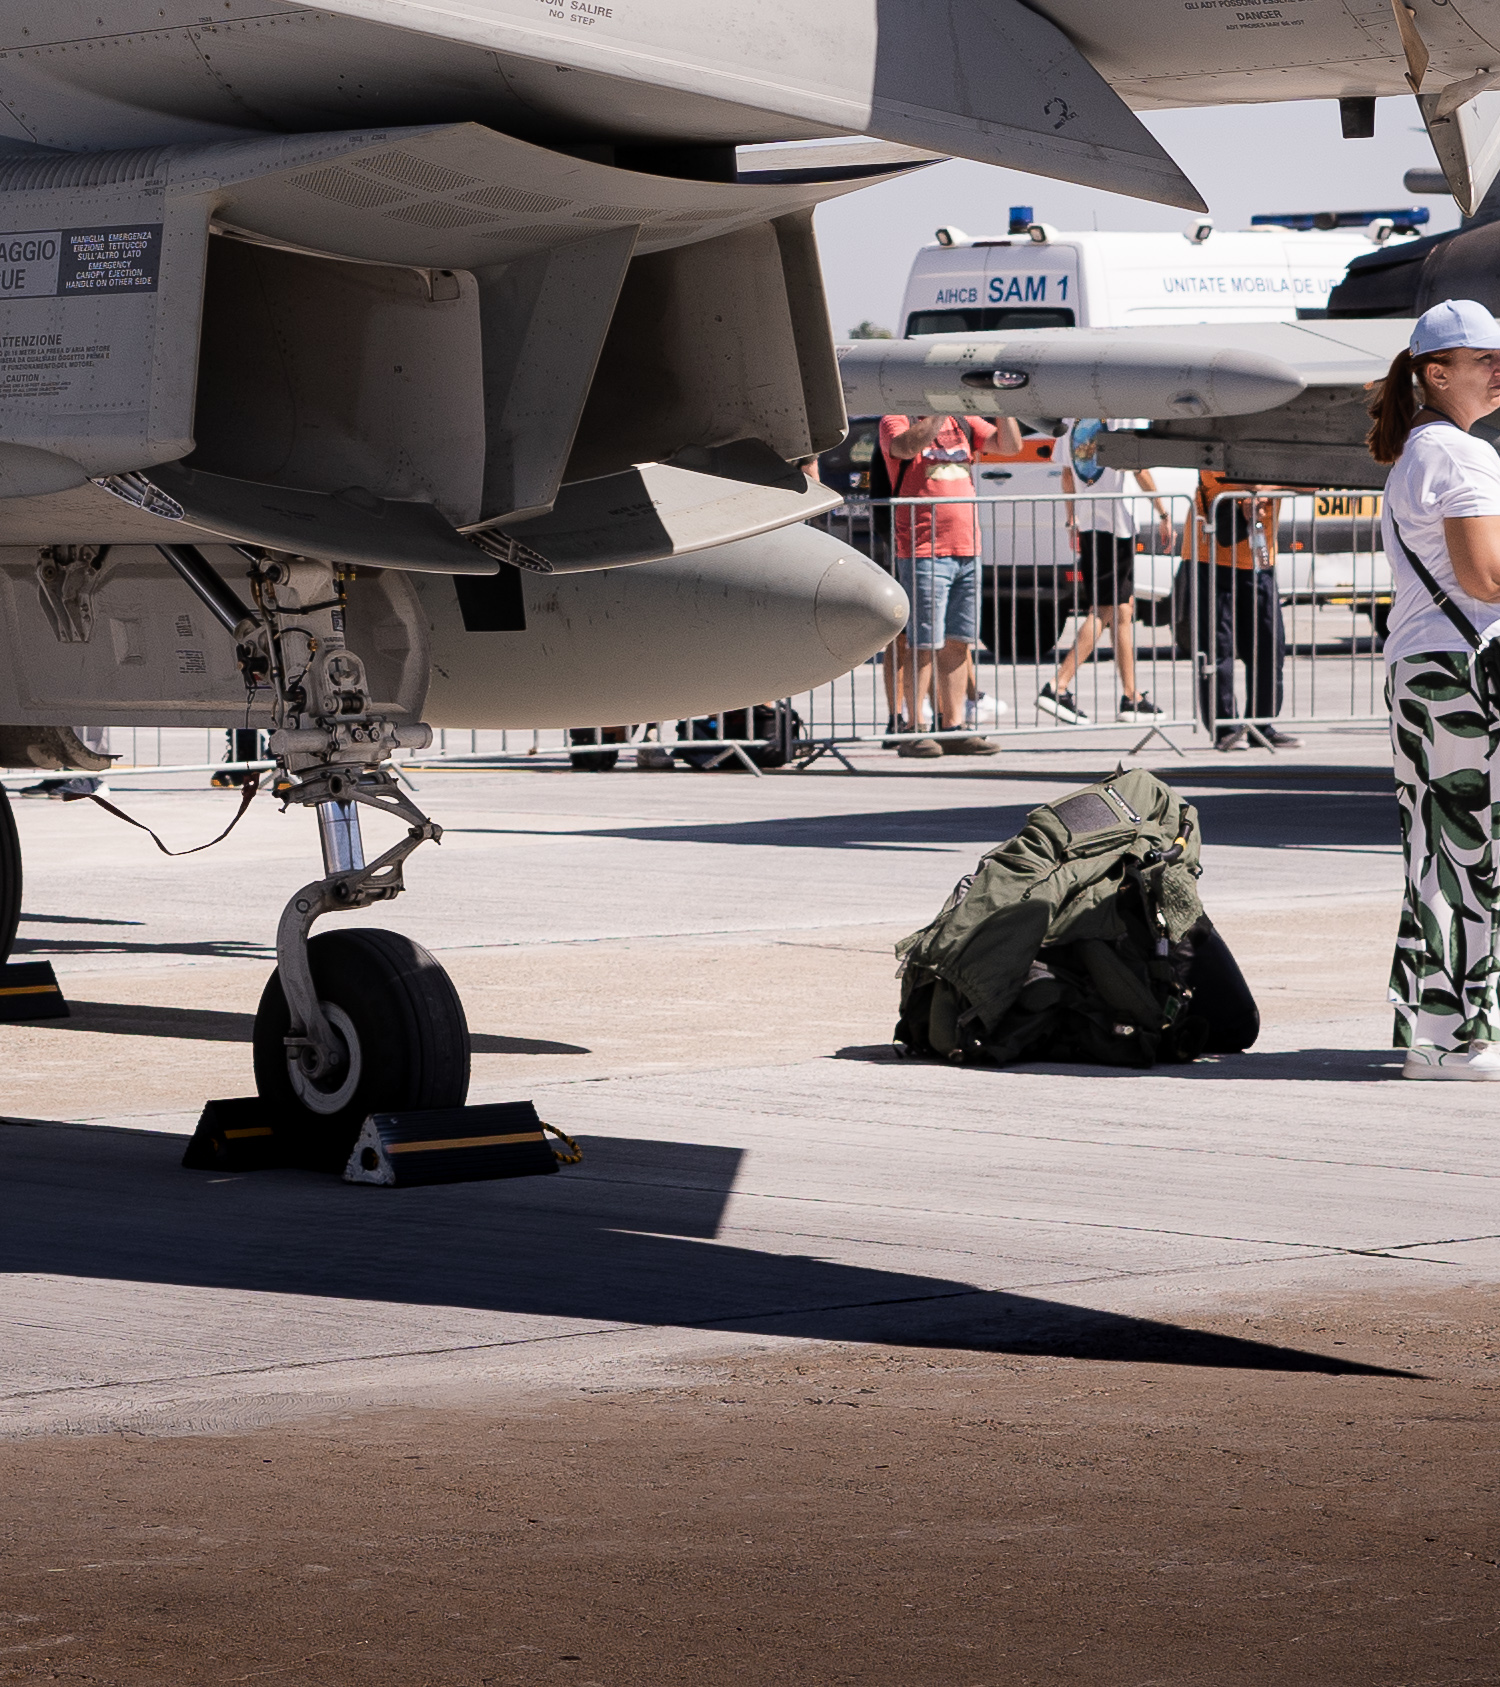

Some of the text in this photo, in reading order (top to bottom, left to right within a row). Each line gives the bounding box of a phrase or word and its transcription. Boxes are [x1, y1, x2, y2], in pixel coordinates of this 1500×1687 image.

[570, 0, 613, 18] SALIRE
[1184, 2, 1199, 10] GLI
[1201, 1, 1218, 9] ADT
[549, 9, 595, 26] NO STEP
[1236, 10, 1283, 21] DANGER
[71, 232, 152, 244] MANIGLIA EMERGENZA
[109, 241, 147, 250] TETTUCCIO
[77, 249, 141, 261] SULL'ALTRO LATO
[88, 261, 131, 270] EMERGENCY
[76, 269, 143, 280] CANOPY EJECTION
[66, 279, 94, 288] HANDLE
[109, 277, 133, 286] OTHER
[135, 276, 152, 285] SIDE
[1163, 277, 1227, 293] UNITATE
[1231, 277, 1290, 293] MOBILA
[1293, 278, 1314, 294] DE
[936, 287, 978, 303] AIHCB
[988, 275, 1069, 303] SAM 1
[6, 374, 39, 383] CAUTION
